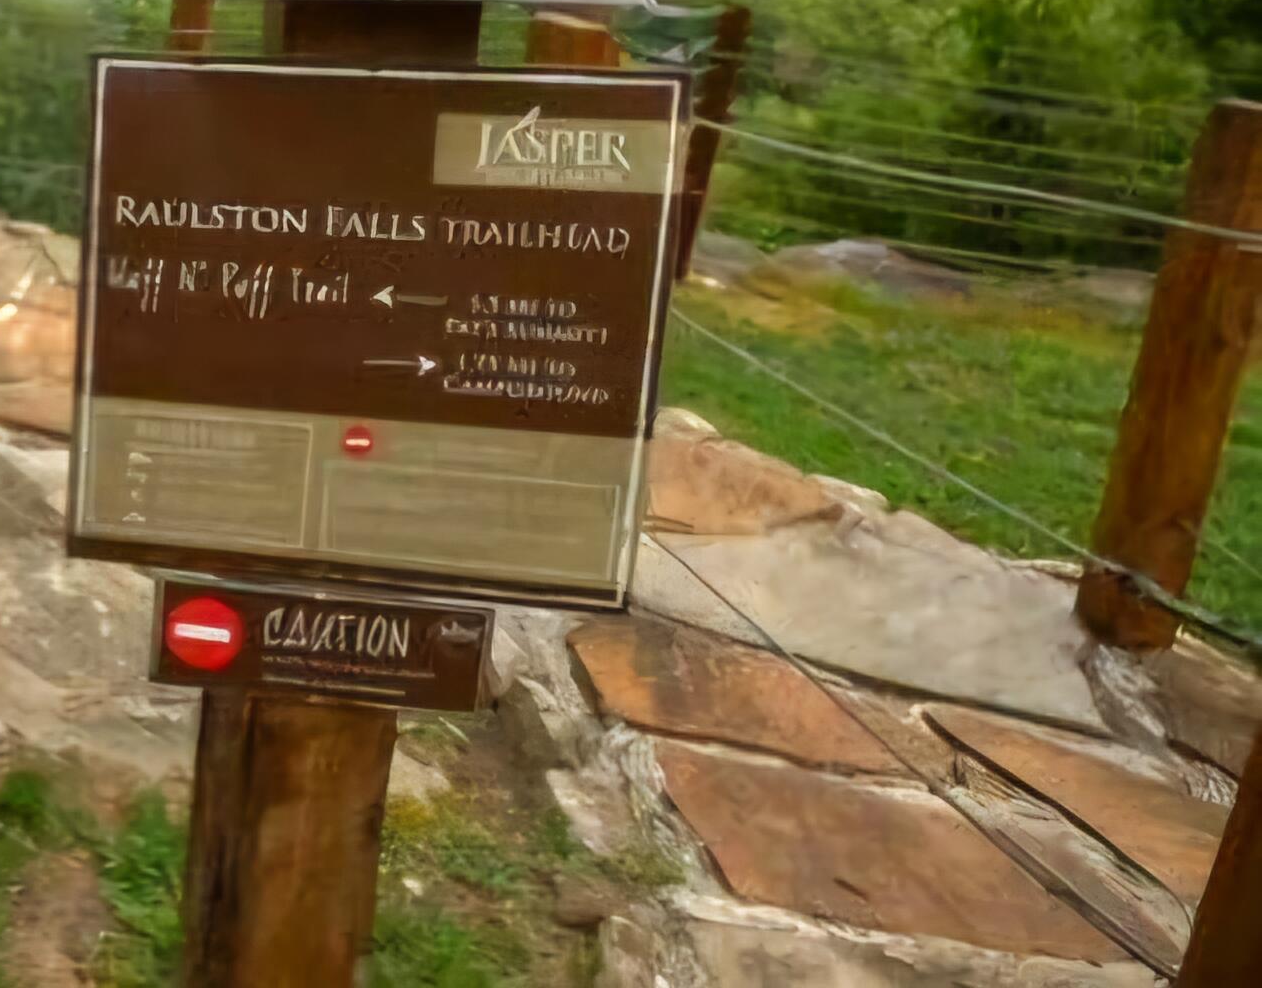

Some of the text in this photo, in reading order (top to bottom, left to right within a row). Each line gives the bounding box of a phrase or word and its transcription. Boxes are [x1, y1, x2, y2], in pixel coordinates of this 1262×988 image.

[476, 108, 631, 172] JASPER
[117, 195, 307, 234] RAULSTON
[325, 205, 426, 241] FALLS
[222, 262, 274, 319] Puff
[264, 607, 410, 658] CAUTION
